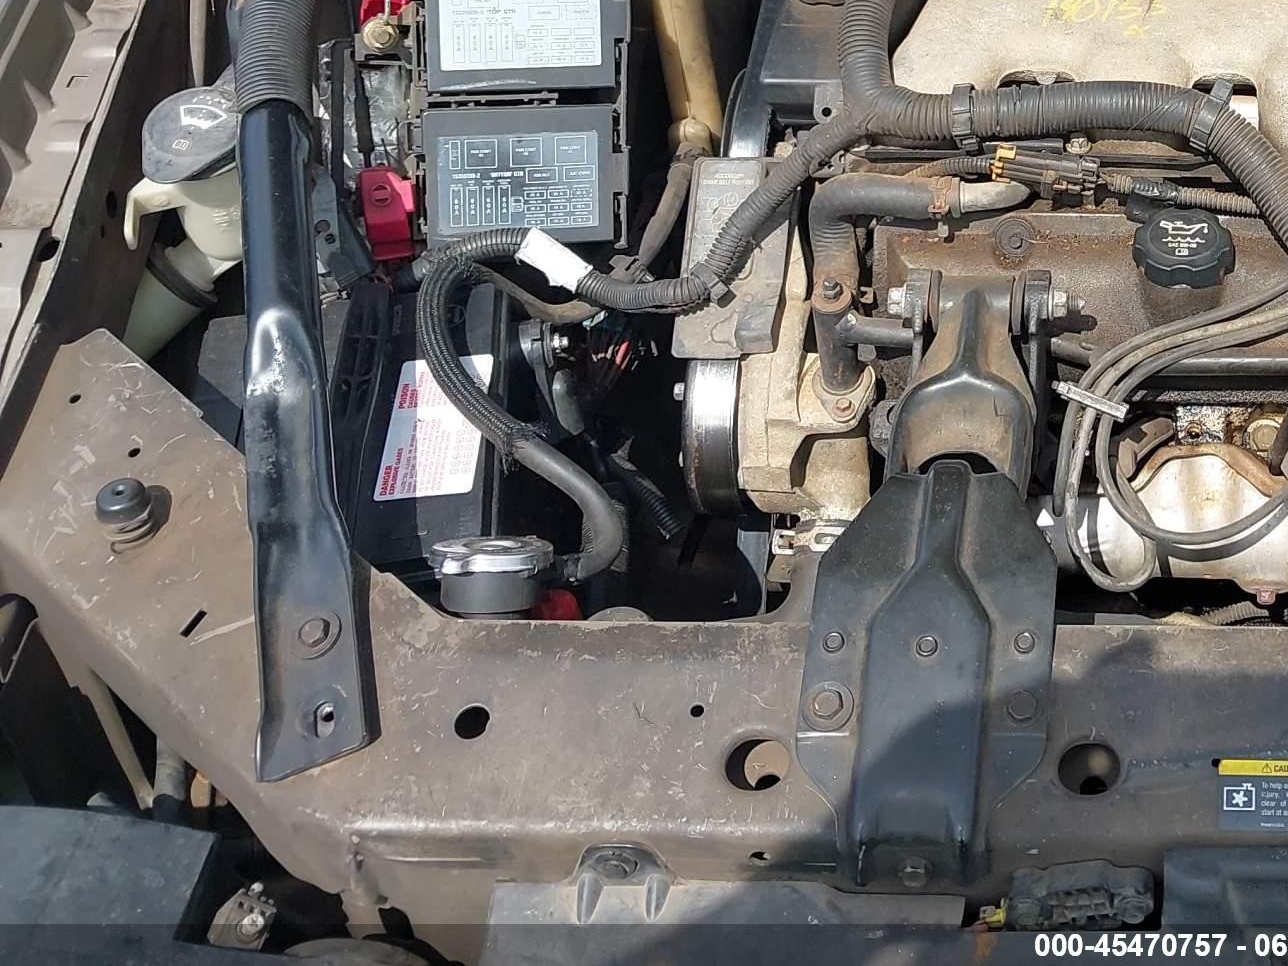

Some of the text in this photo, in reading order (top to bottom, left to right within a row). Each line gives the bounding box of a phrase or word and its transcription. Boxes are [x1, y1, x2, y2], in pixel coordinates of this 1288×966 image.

[398, 383, 411, 410] POISON
[379, 465, 393, 496] DANGER
[1269, 782, 1282, 790] help
